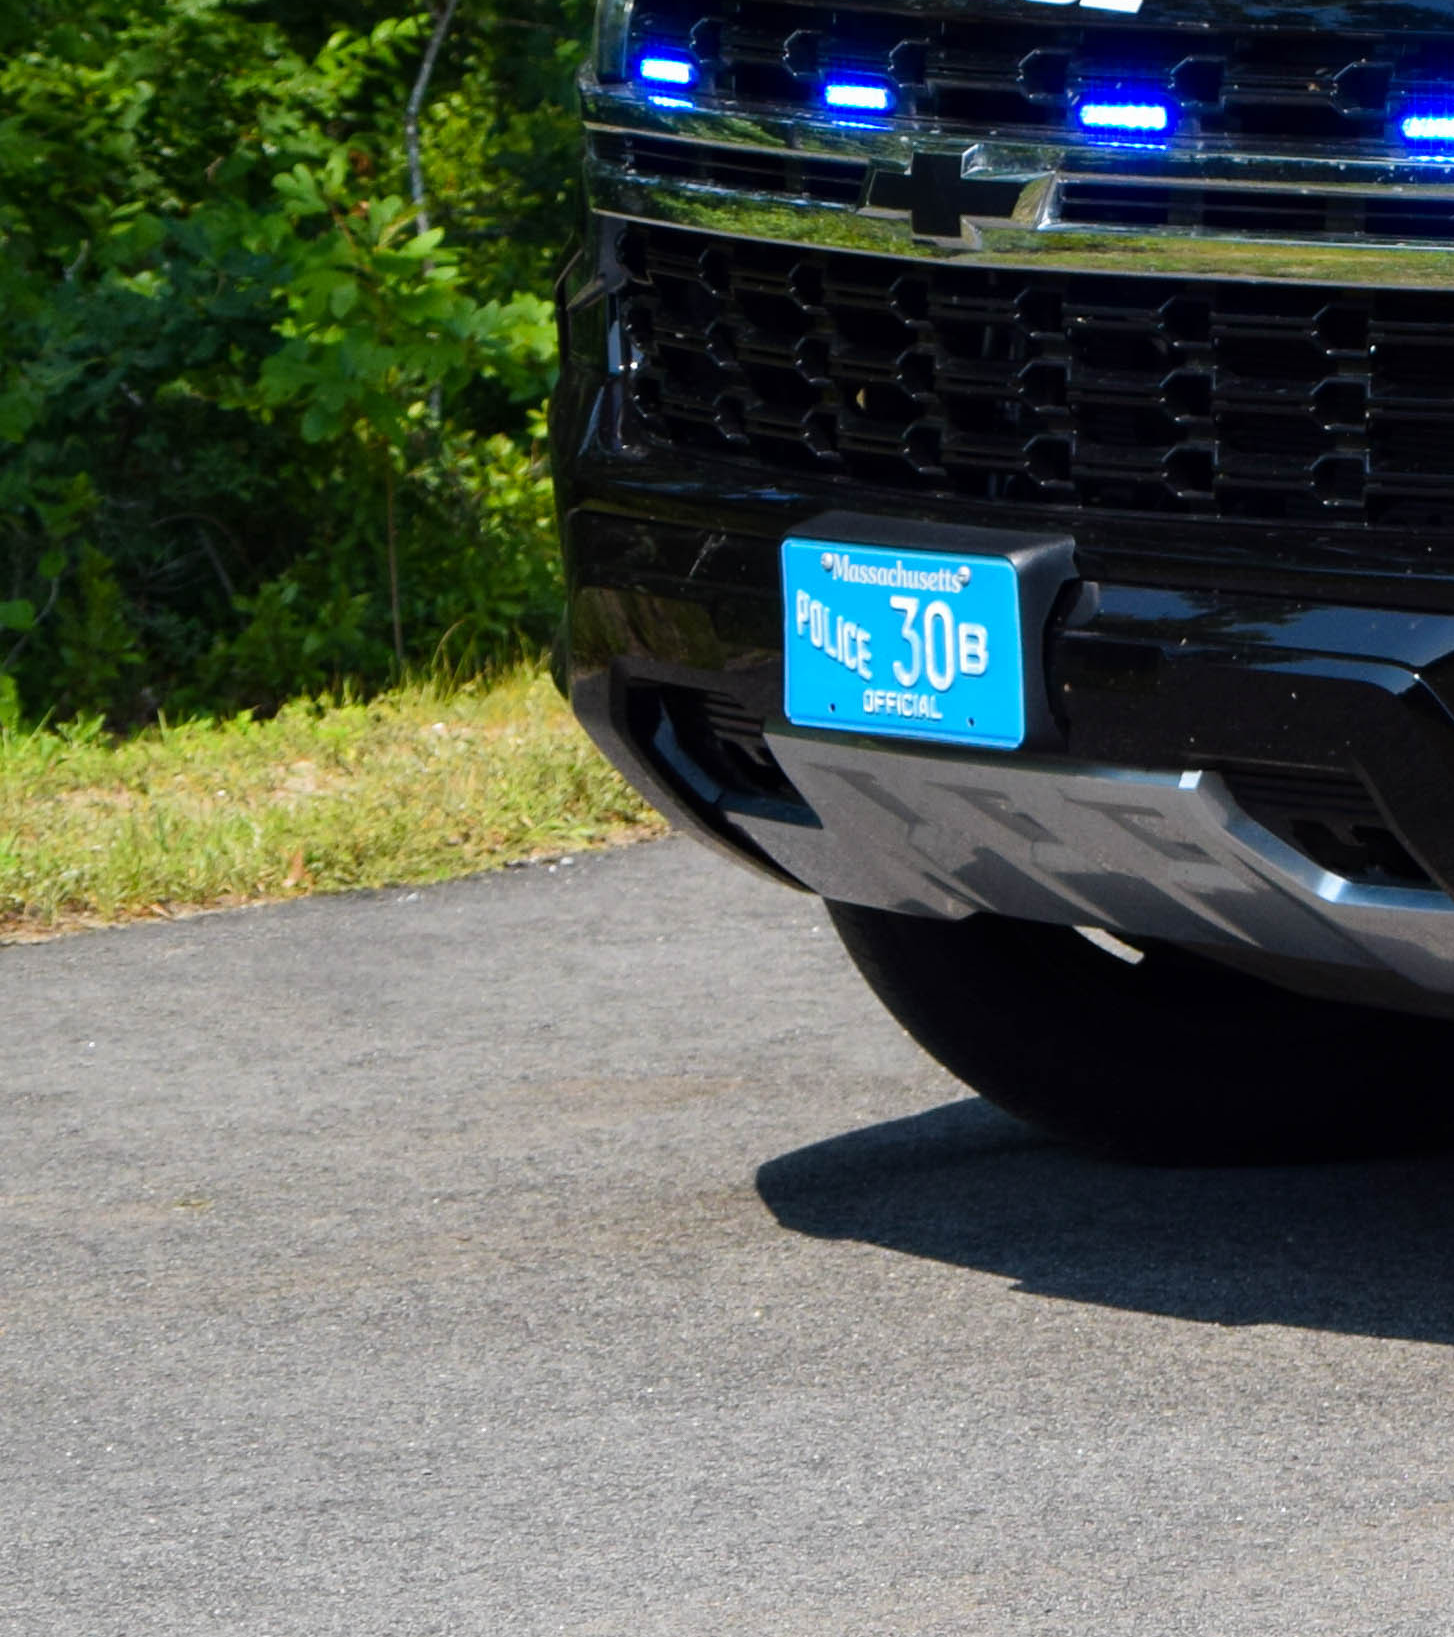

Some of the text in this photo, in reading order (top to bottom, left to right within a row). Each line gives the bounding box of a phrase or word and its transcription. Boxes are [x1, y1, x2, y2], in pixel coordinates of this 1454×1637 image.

[832, 553, 962, 593] Massachusetts
[796, 589, 873, 681] POLICE
[863, 689, 943, 721] OFFICIAL
